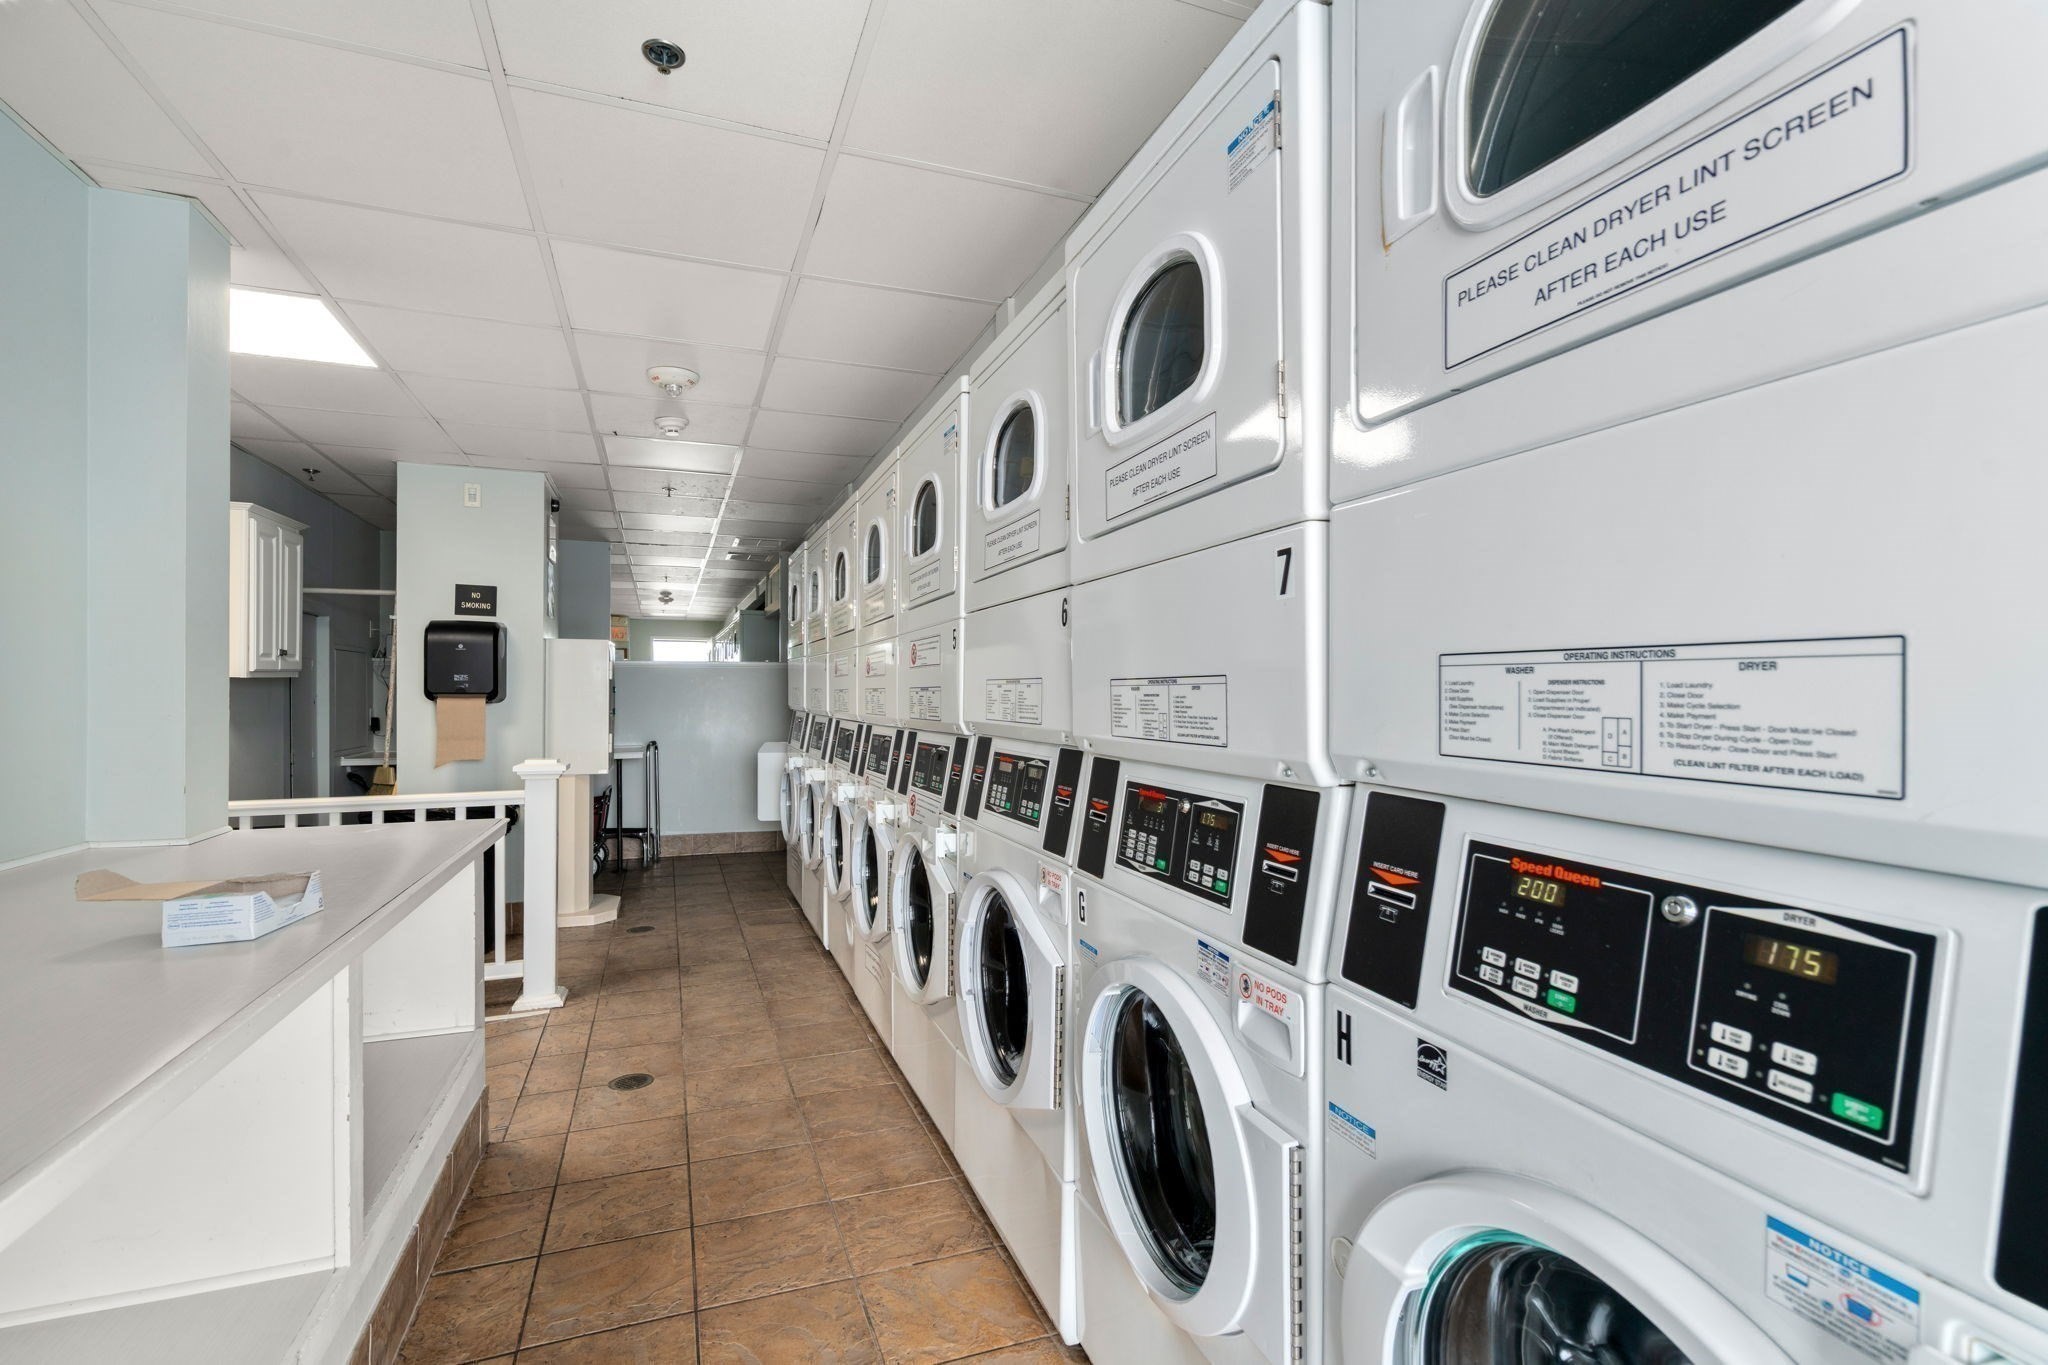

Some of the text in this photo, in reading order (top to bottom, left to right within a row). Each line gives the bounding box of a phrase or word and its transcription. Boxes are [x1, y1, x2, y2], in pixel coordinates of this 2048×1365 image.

[1458, 77, 1873, 307] PLEASE CLEAN DRYER LINT SCREEN
[1534, 199, 1727, 306] AFTER EACH USE
[1110, 429, 1211, 488] PLEASE CLEAN DRYER LINT SCREEN
[1132, 481, 1150, 497] AFTER
[1150, 473, 1167, 489] EACH
[1168, 466, 1181, 481] USE
[1277, 547, 1292, 595] 7
[461, 601, 491, 610] SMOKING
[1061, 597, 1068, 627] 6
[952, 628, 957, 650] 5
[1563, 649, 1676, 661] OPERATING INSTRUCTIONS
[1738, 661, 1778, 671] DRYER
[1505, 666, 1535, 674] WASHER
[1666, 681, 1683, 689] Load
[1685, 681, 1713, 690] Laundry
[1666, 691, 1685, 699] Close
[1686, 702, 1706, 711] Cycle
[1707, 702, 1740, 710] Selection
[1686, 712, 1717, 721] Payment
[1673, 759, 1706, 769] (CLEAN
[1706, 761, 1726, 770] LINT
[1728, 763, 1760, 773] FILTER
[1762, 765, 1795, 776] AFTER
[1797, 768, 1827, 778] EACH
[1266, 842, 1300, 856] INSERT CARD HERE
[1373, 861, 1419, 879] INSERT CARD HERE
[1511, 857, 1601, 888] Speed Queen
[1517, 877, 1558, 903] 200
[1079, 891, 1086, 923] G
[1782, 911, 1817, 928] DRYER
[1767, 941, 1822, 977] 175
[1254, 980, 1288, 1004] NO PODS
[1255, 995, 1285, 1017] IN TRAY
[1523, 1003, 1548, 1019] WASHER
[1337, 1010, 1352, 1067] H
[1334, 1106, 1371, 1135] NOTICE
[1808, 1238, 1871, 1278] NOTICE
